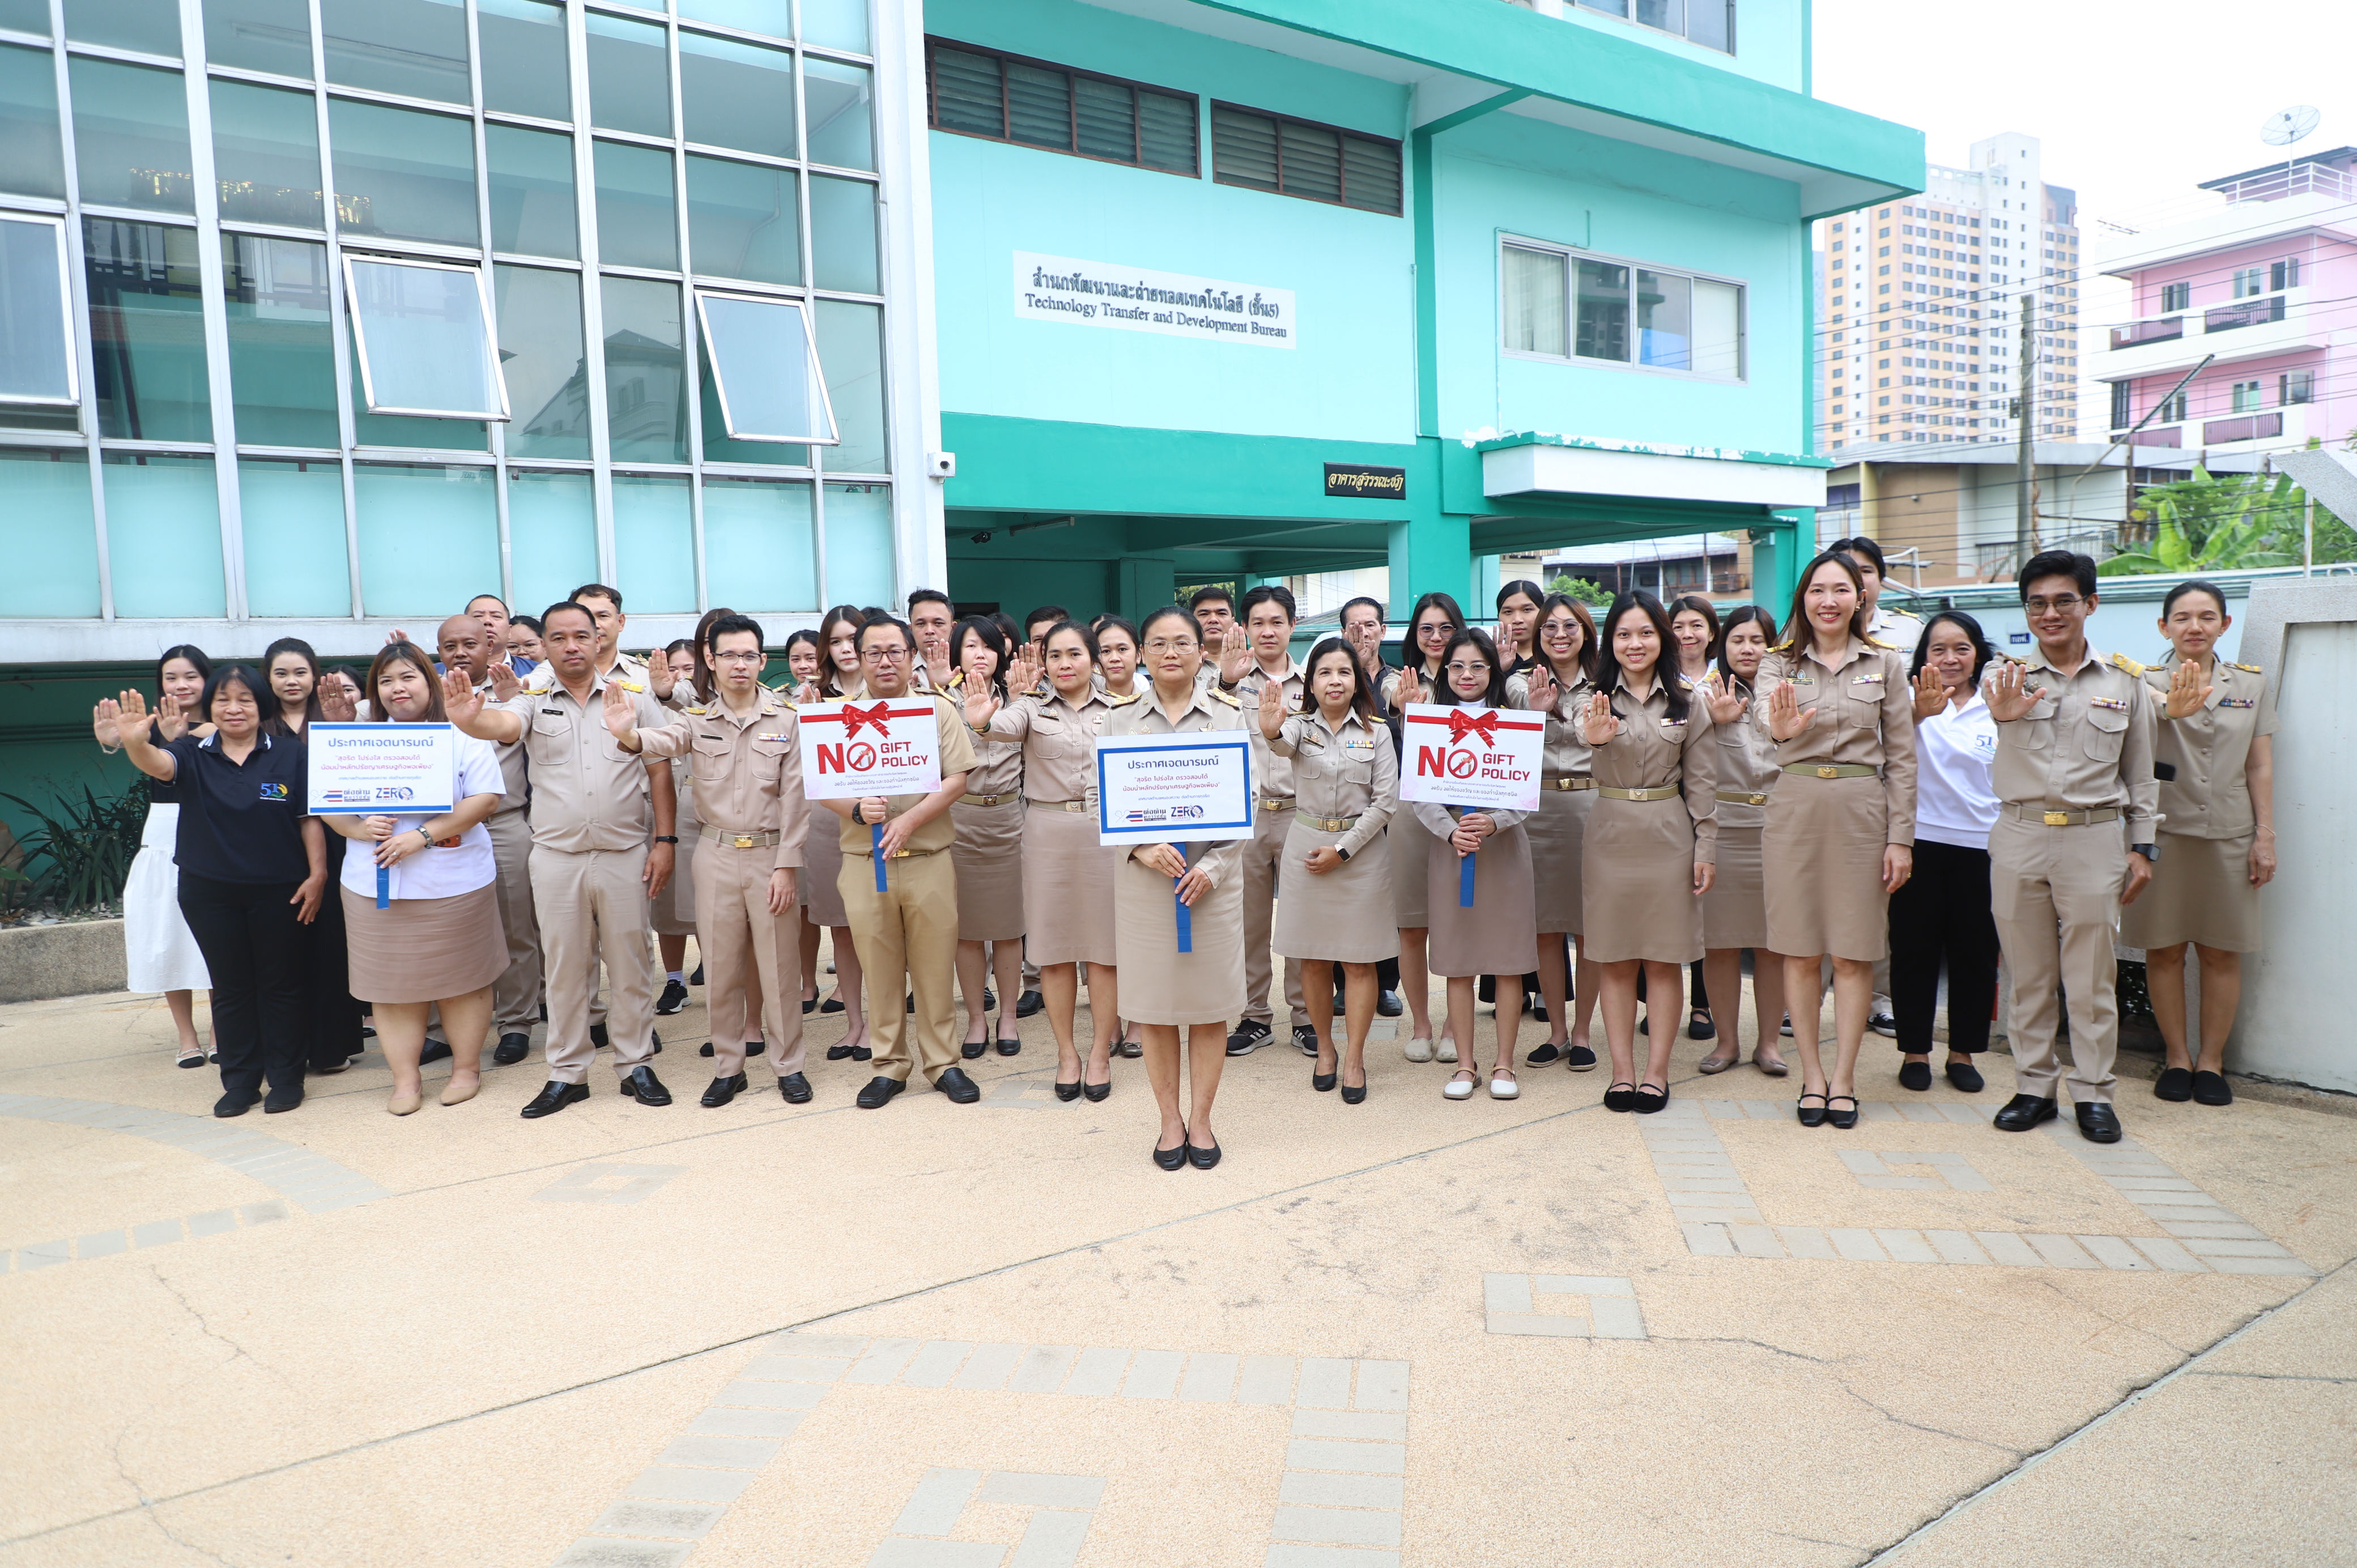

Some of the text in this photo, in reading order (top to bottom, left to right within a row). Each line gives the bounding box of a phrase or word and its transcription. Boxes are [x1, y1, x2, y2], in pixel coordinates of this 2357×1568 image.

[1248, 292, 1279, 319] (ชั้น5)
[1025, 293, 1287, 338] Technology Transfer and Development Bureau
[329, 736, 433, 747] ประกาศเจตนารมณ์
[1975, 734, 1993, 747] 51
[880, 742, 911, 754] GIFT
[882, 755, 929, 768] POLICY
[1128, 756, 1219, 769] ประกาศเจตนารมณ์
[1482, 753, 1515, 766] GIFT
[1481, 768, 1531, 782] POLICY
[259, 783, 279, 796] 51
[1444, 785, 1472, 794] งดให้ของขวัญ
[1473, 789, 1518, 798] และของกำนัลทุกชนิด
